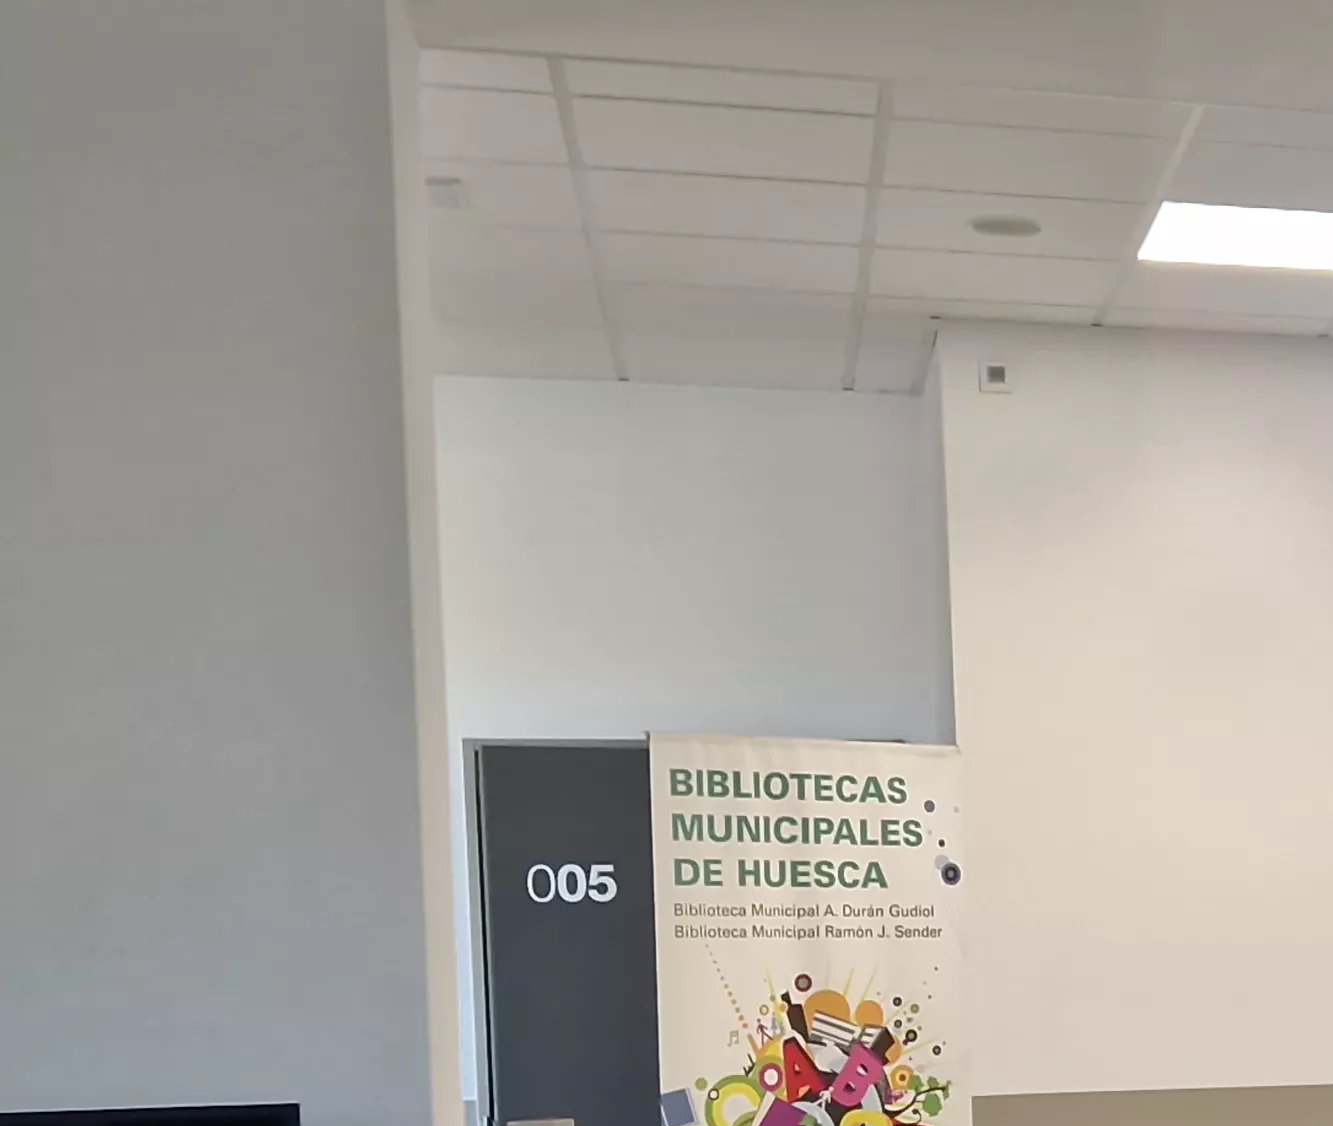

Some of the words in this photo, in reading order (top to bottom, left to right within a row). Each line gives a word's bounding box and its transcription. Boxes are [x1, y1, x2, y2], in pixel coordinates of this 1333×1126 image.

[668, 768, 908, 804] BIBLIOTECAS
[671, 813, 923, 847] MUNICIPALES
[526, 863, 618, 903] 005
[673, 858, 723, 887] DE
[738, 859, 889, 889] HUESCA
[673, 903, 747, 918] Biblioteca
[751, 903, 820, 919] Municipal
[824, 904, 838, 918] A.
[842, 903, 884, 918] Durán
[889, 904, 935, 918] Gudiol
[674, 925, 747, 939] Biblioteca
[751, 925, 820, 941] Municipal
[825, 925, 873, 939] Ramón
[877, 925, 891, 939] J.
[894, 925, 943, 939] Sender
